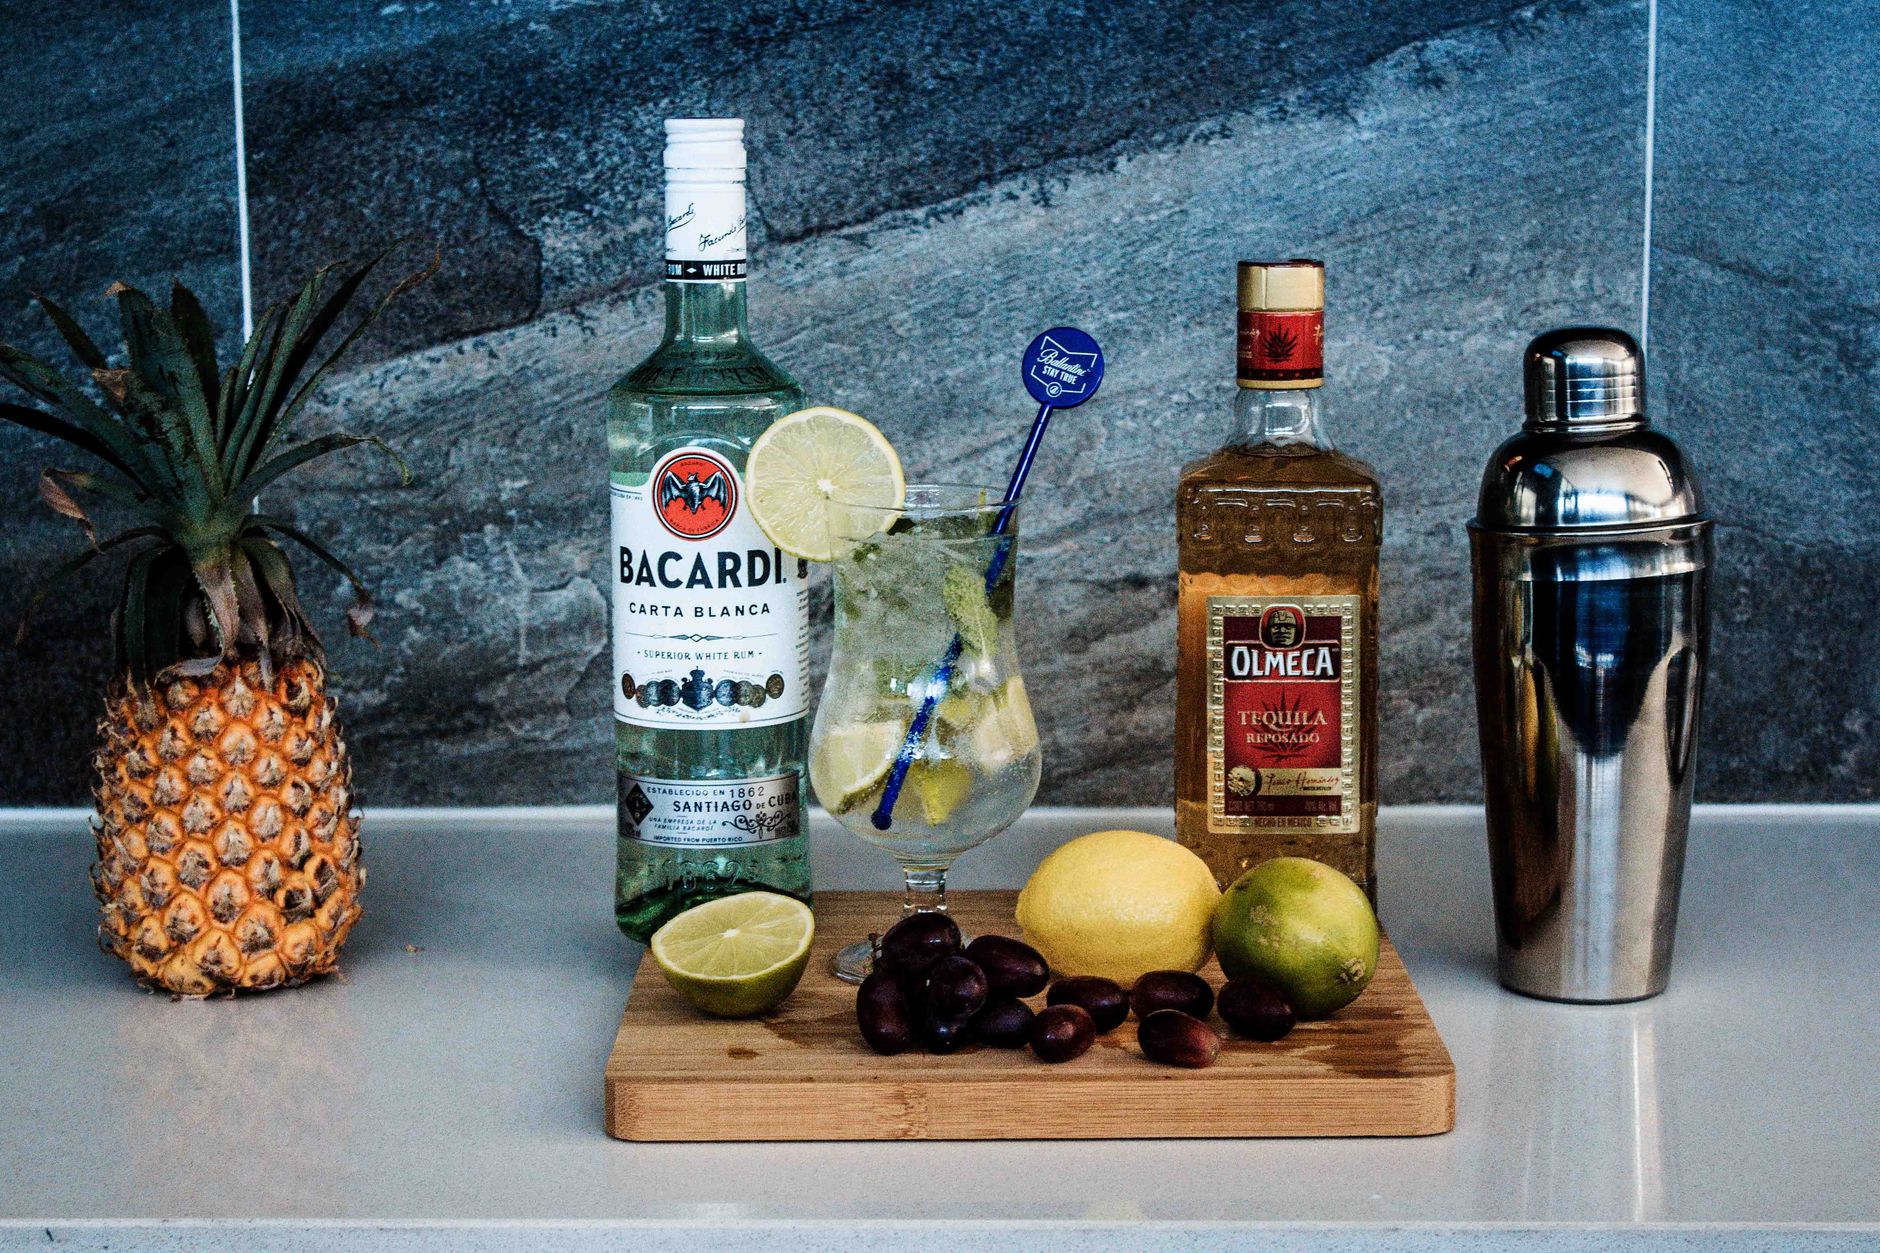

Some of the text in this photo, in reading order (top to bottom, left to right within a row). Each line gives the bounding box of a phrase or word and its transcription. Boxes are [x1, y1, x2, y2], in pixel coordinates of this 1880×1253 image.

[702, 264, 735, 276] WHITE
[1041, 365, 1078, 385] STAY TRUE
[619, 546, 783, 589] BACARDI
[629, 602, 770, 618] CARTA BLANCA
[643, 649, 755, 661] SUPERIOR WHITE RUM
[1231, 646, 1334, 677] OLMECA
[1237, 710, 1328, 732] TEQUILA
[1246, 732, 1320, 743] REPOSADO
[647, 786, 765, 799] ESTABLECIDO EN 1862
[673, 799, 752, 813] SANTIAGO
[767, 791, 797, 808] CUBA
[653, 835, 682, 843] IMPORTED
